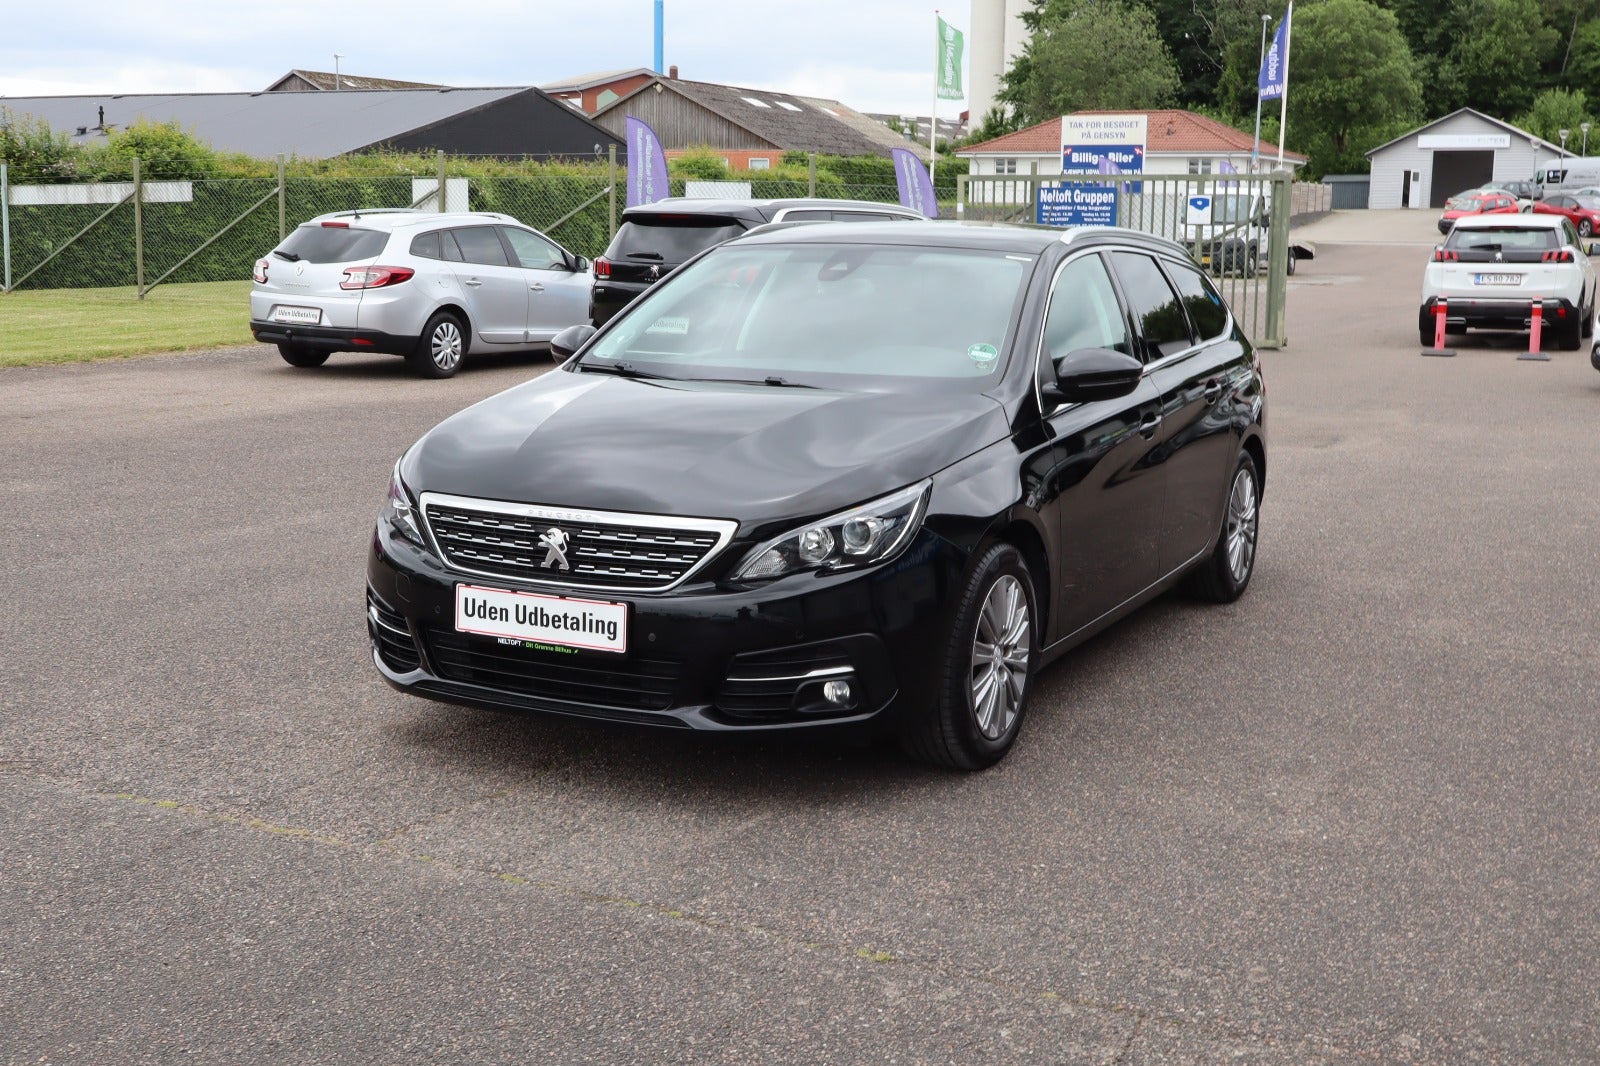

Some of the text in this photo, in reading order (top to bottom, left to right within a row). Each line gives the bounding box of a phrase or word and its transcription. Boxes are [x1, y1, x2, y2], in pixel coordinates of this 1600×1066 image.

[1069, 120, 1139, 130] TAK FOR BESØGET
[1081, 130, 1126, 140] PÅ GENSYN
[1108, 152, 1134, 163] Biler
[1040, 189, 1115, 205] Neltoft Gruppen
[277, 308, 318, 320] Uden Udbetaling
[527, 509, 593, 520] PEUGEOT
[463, 597, 618, 641] Uden Udbetaling
[497, 637, 523, 647] NELTOFT
